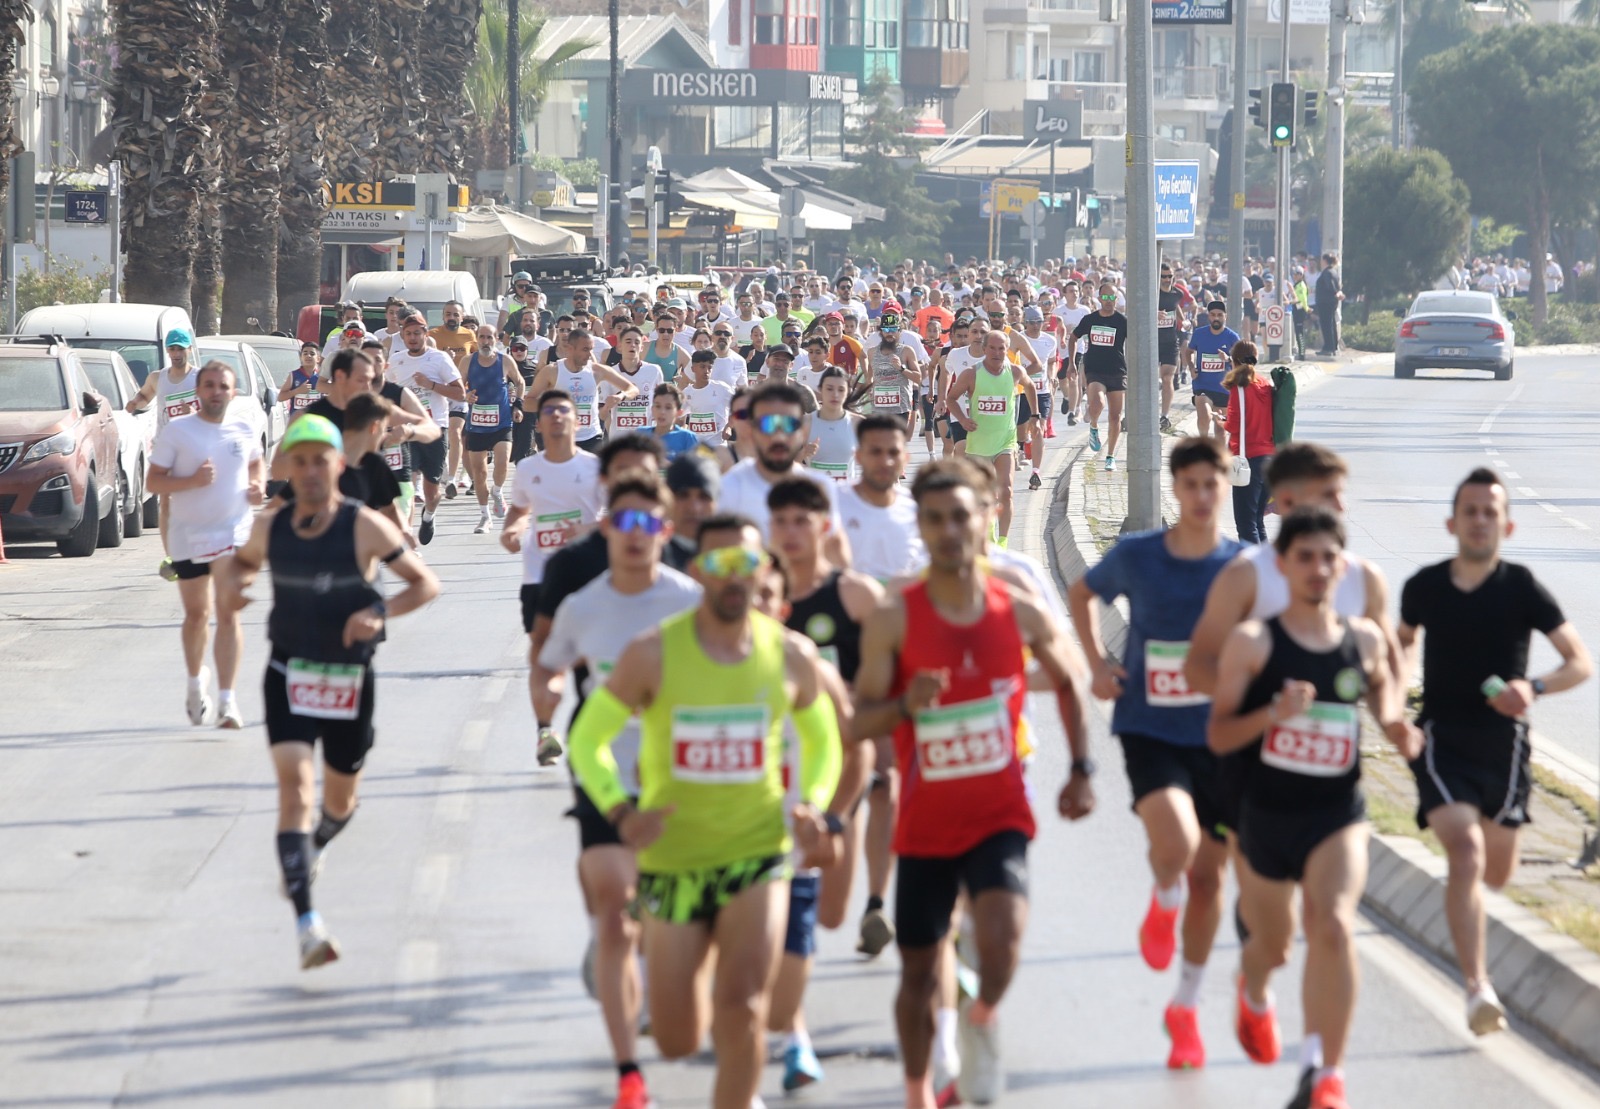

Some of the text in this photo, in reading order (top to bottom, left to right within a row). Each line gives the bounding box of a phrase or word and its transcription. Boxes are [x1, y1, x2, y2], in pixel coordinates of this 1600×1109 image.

[1180, 1, 1189, 19] 2
[1190, 6, 1225, 19] ÖĞRETMEN
[1157, 174, 1171, 200] Yaya
[75, 200, 98, 210] 1724.
[877, 396, 897, 404] 0316
[978, 401, 1003, 411] 0973
[473, 414, 497, 423] 0646
[620, 417, 644, 426] 0323
[691, 423, 713, 431] 0163
